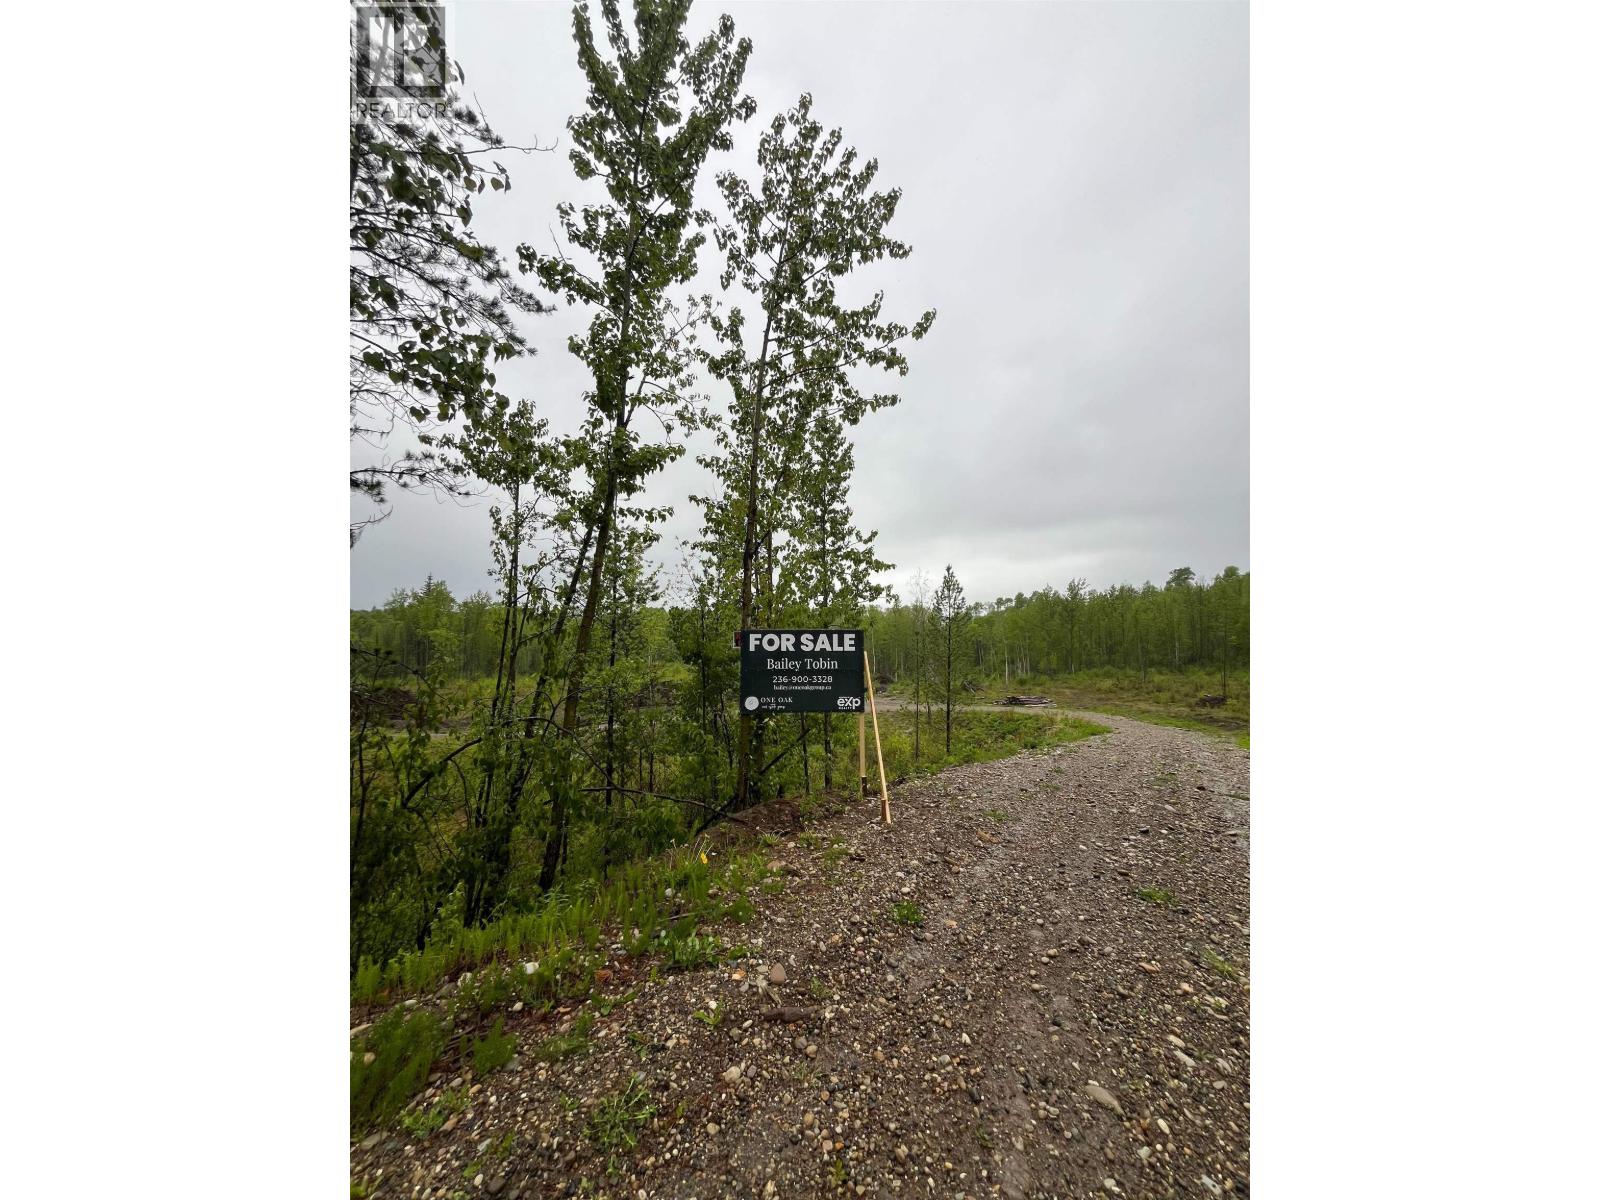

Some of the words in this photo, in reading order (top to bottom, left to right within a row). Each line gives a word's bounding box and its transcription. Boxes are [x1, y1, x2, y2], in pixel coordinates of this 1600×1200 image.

[749, 633, 796, 652] FOR
[800, 633, 856, 652] SALE
[767, 658, 802, 672] Bailey
[804, 658, 838, 670] Tobin
[772, 675, 833, 683] 236-900-3328
